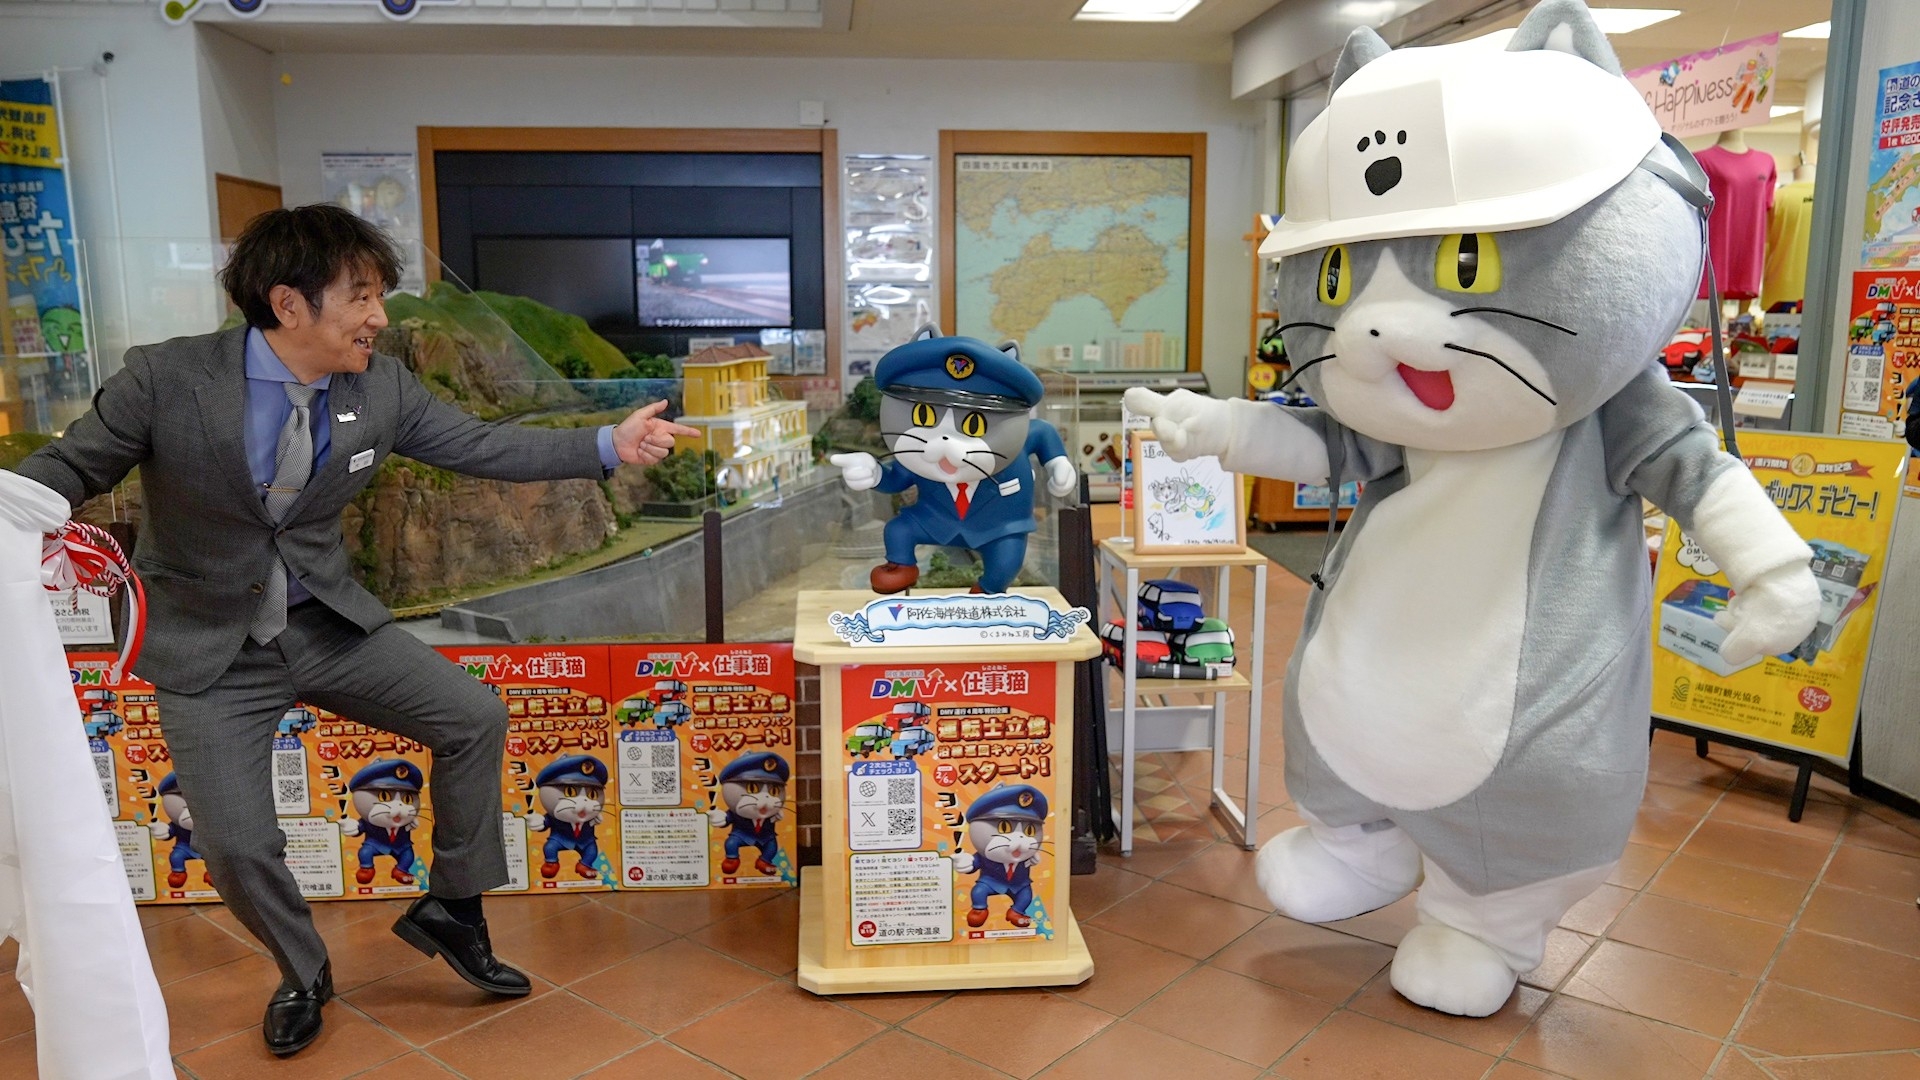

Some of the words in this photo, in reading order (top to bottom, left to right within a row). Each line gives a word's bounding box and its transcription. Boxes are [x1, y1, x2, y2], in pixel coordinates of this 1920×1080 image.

[1866, 281, 1907, 299] DMV
[907, 605, 1027, 620] 阿佐海岸鉄道株式会社
[458, 660, 511, 680] MV
[526, 656, 586, 679] 仕事猫
[636, 656, 697, 677] DMV
[712, 654, 771, 676] 仕事猫
[870, 674, 943, 699] DMV
[961, 670, 1029, 696] 仕事猫
[1694, 682, 1762, 705] 海陽町観光協会
[507, 696, 608, 718] 運転士立像
[692, 693, 791, 715] 運転士立像
[936, 715, 1051, 742] 運転士立像
[527, 730, 609, 755] スタート！
[711, 729, 792, 751] スタート！
[938, 742, 1053, 759] 沿線巡回キャラバン
[958, 756, 1051, 785] スタート！
[879, 927, 904, 937] 道の駅
[906, 926, 940, 936] 宍喰温泉
